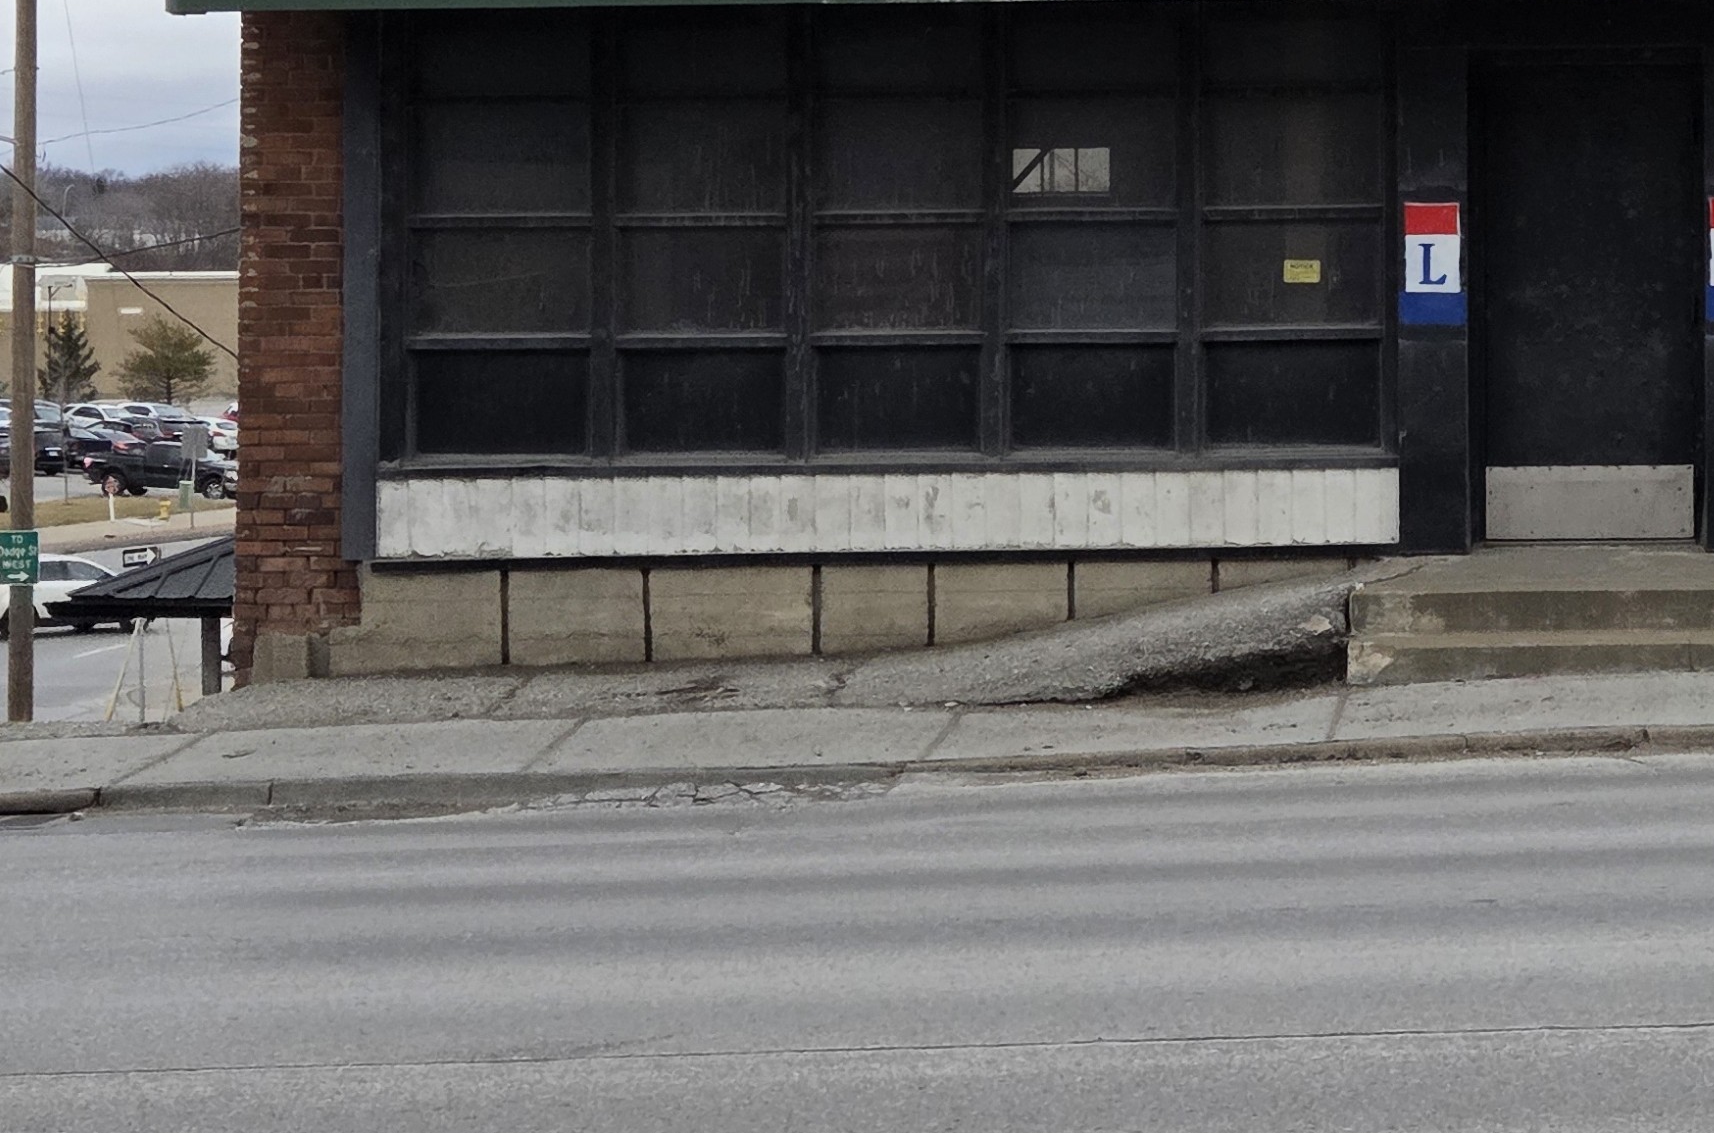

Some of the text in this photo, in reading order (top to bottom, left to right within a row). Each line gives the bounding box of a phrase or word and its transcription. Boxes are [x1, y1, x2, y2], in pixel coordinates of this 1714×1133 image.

[1418, 243, 1447, 285] L
[11, 534, 23, 544] TO
[2, 560, 31, 569] WEST
